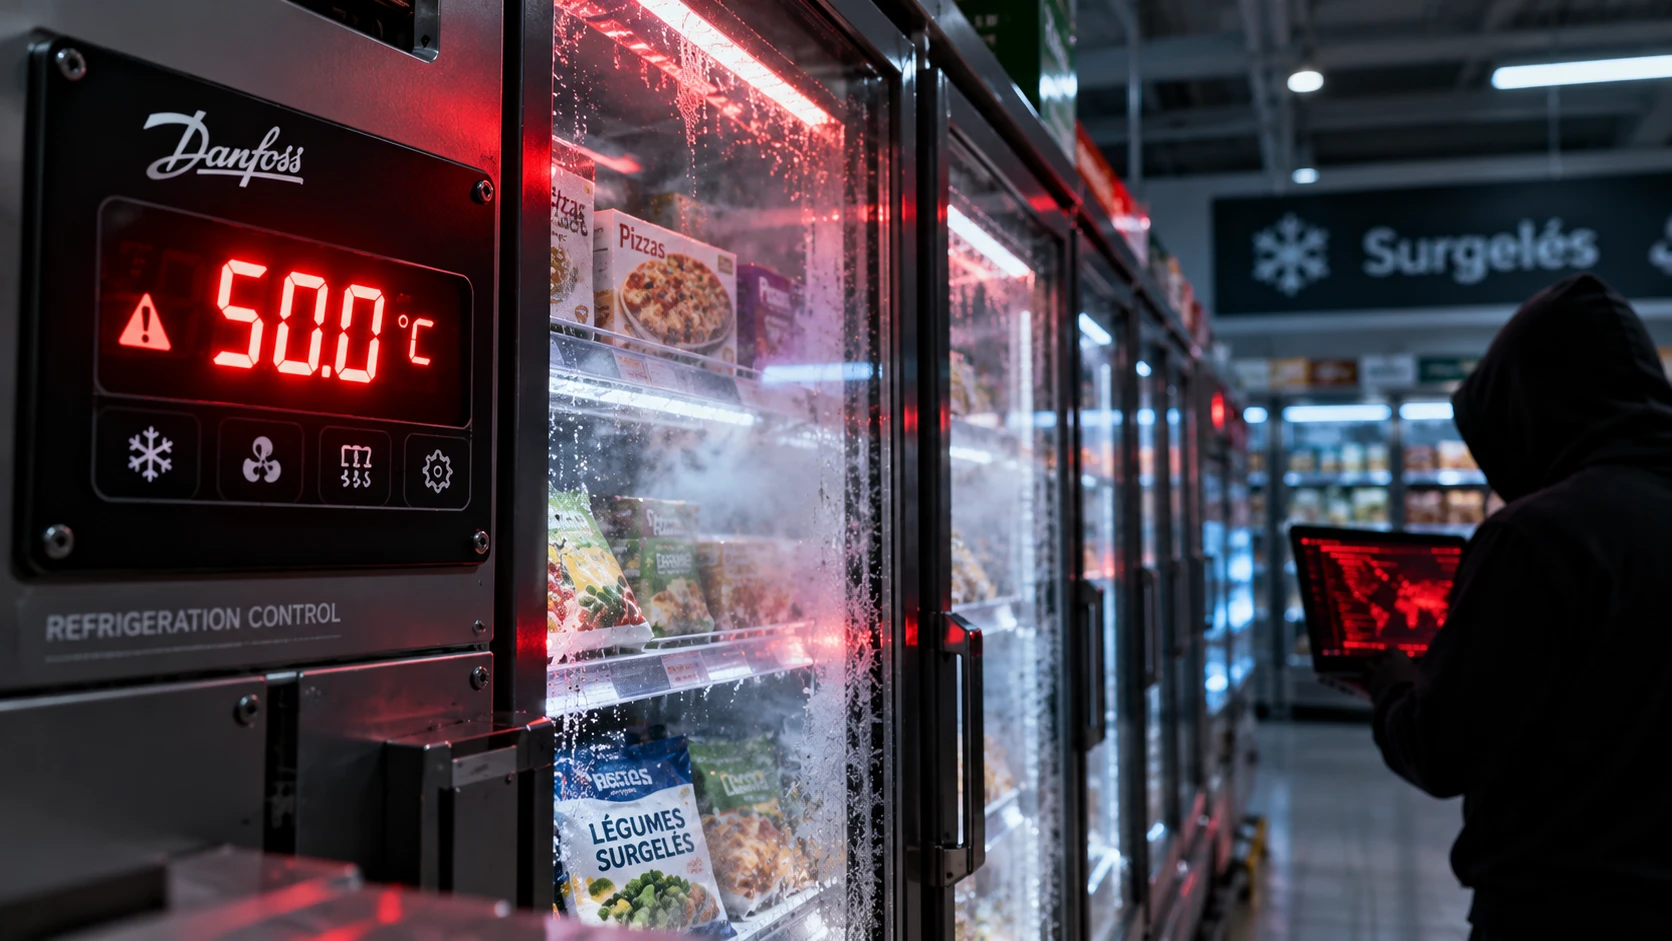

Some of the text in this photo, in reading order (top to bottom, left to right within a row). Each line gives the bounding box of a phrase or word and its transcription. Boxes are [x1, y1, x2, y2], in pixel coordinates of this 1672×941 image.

[143, 110, 305, 188] Danfoss
[619, 222, 666, 259] Pizzas
[1362, 216, 1600, 285] Surgelés
[213, 258, 386, 384] 50.0
[45, 602, 341, 642] REFRIGERATION CONTROL
[589, 807, 686, 846] LÉGUMES
[596, 832, 695, 872] SURGELÉS
